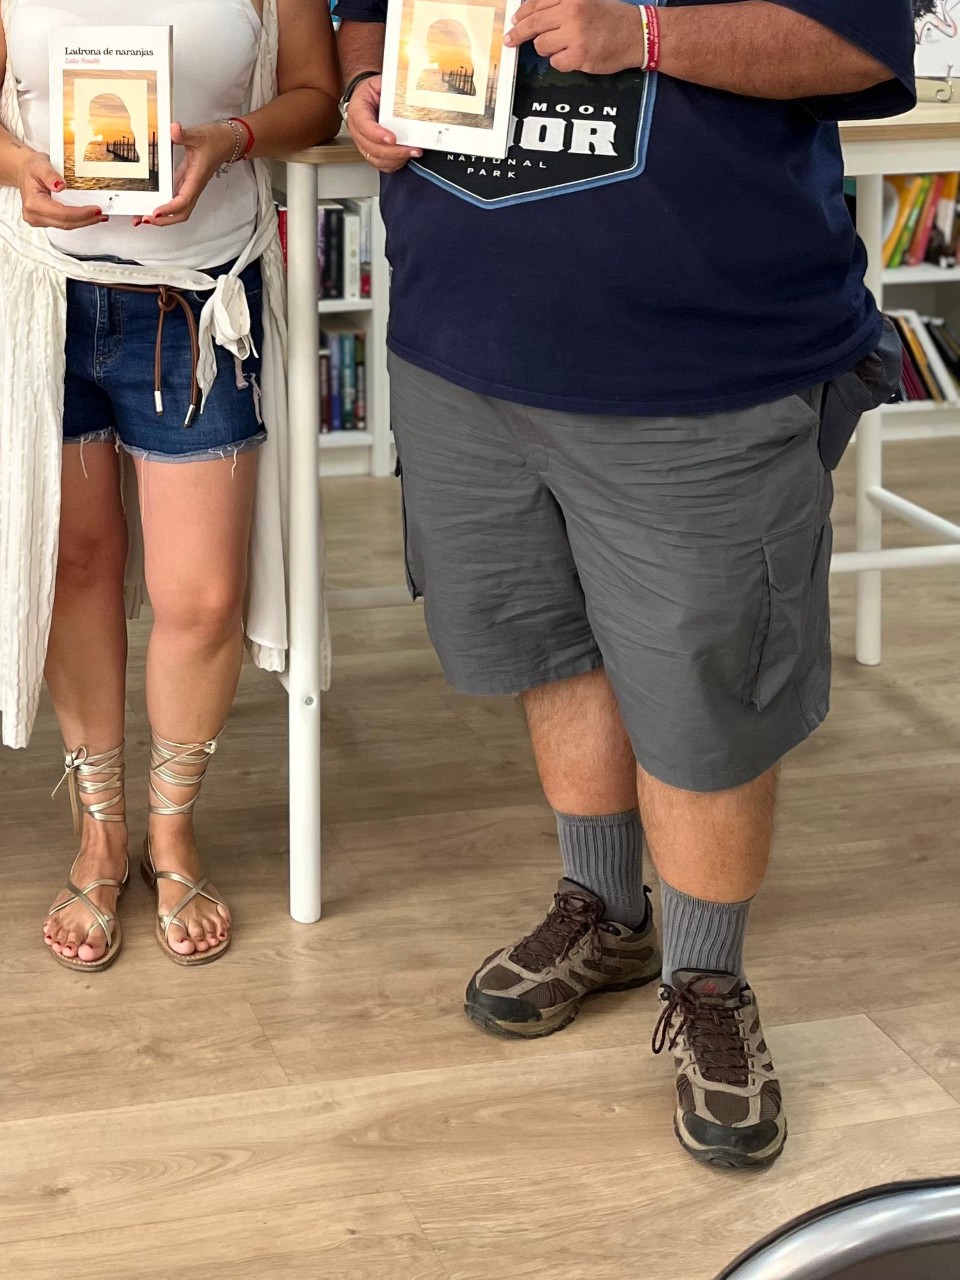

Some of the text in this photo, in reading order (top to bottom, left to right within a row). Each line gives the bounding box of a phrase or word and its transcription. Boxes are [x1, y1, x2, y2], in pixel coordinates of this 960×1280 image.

[65, 47, 154, 57] Ladrona de naranjas
[532, 102, 618, 116] MOON
[447, 154, 547, 169] NATIONAL
[467, 167, 516, 179] PARK
